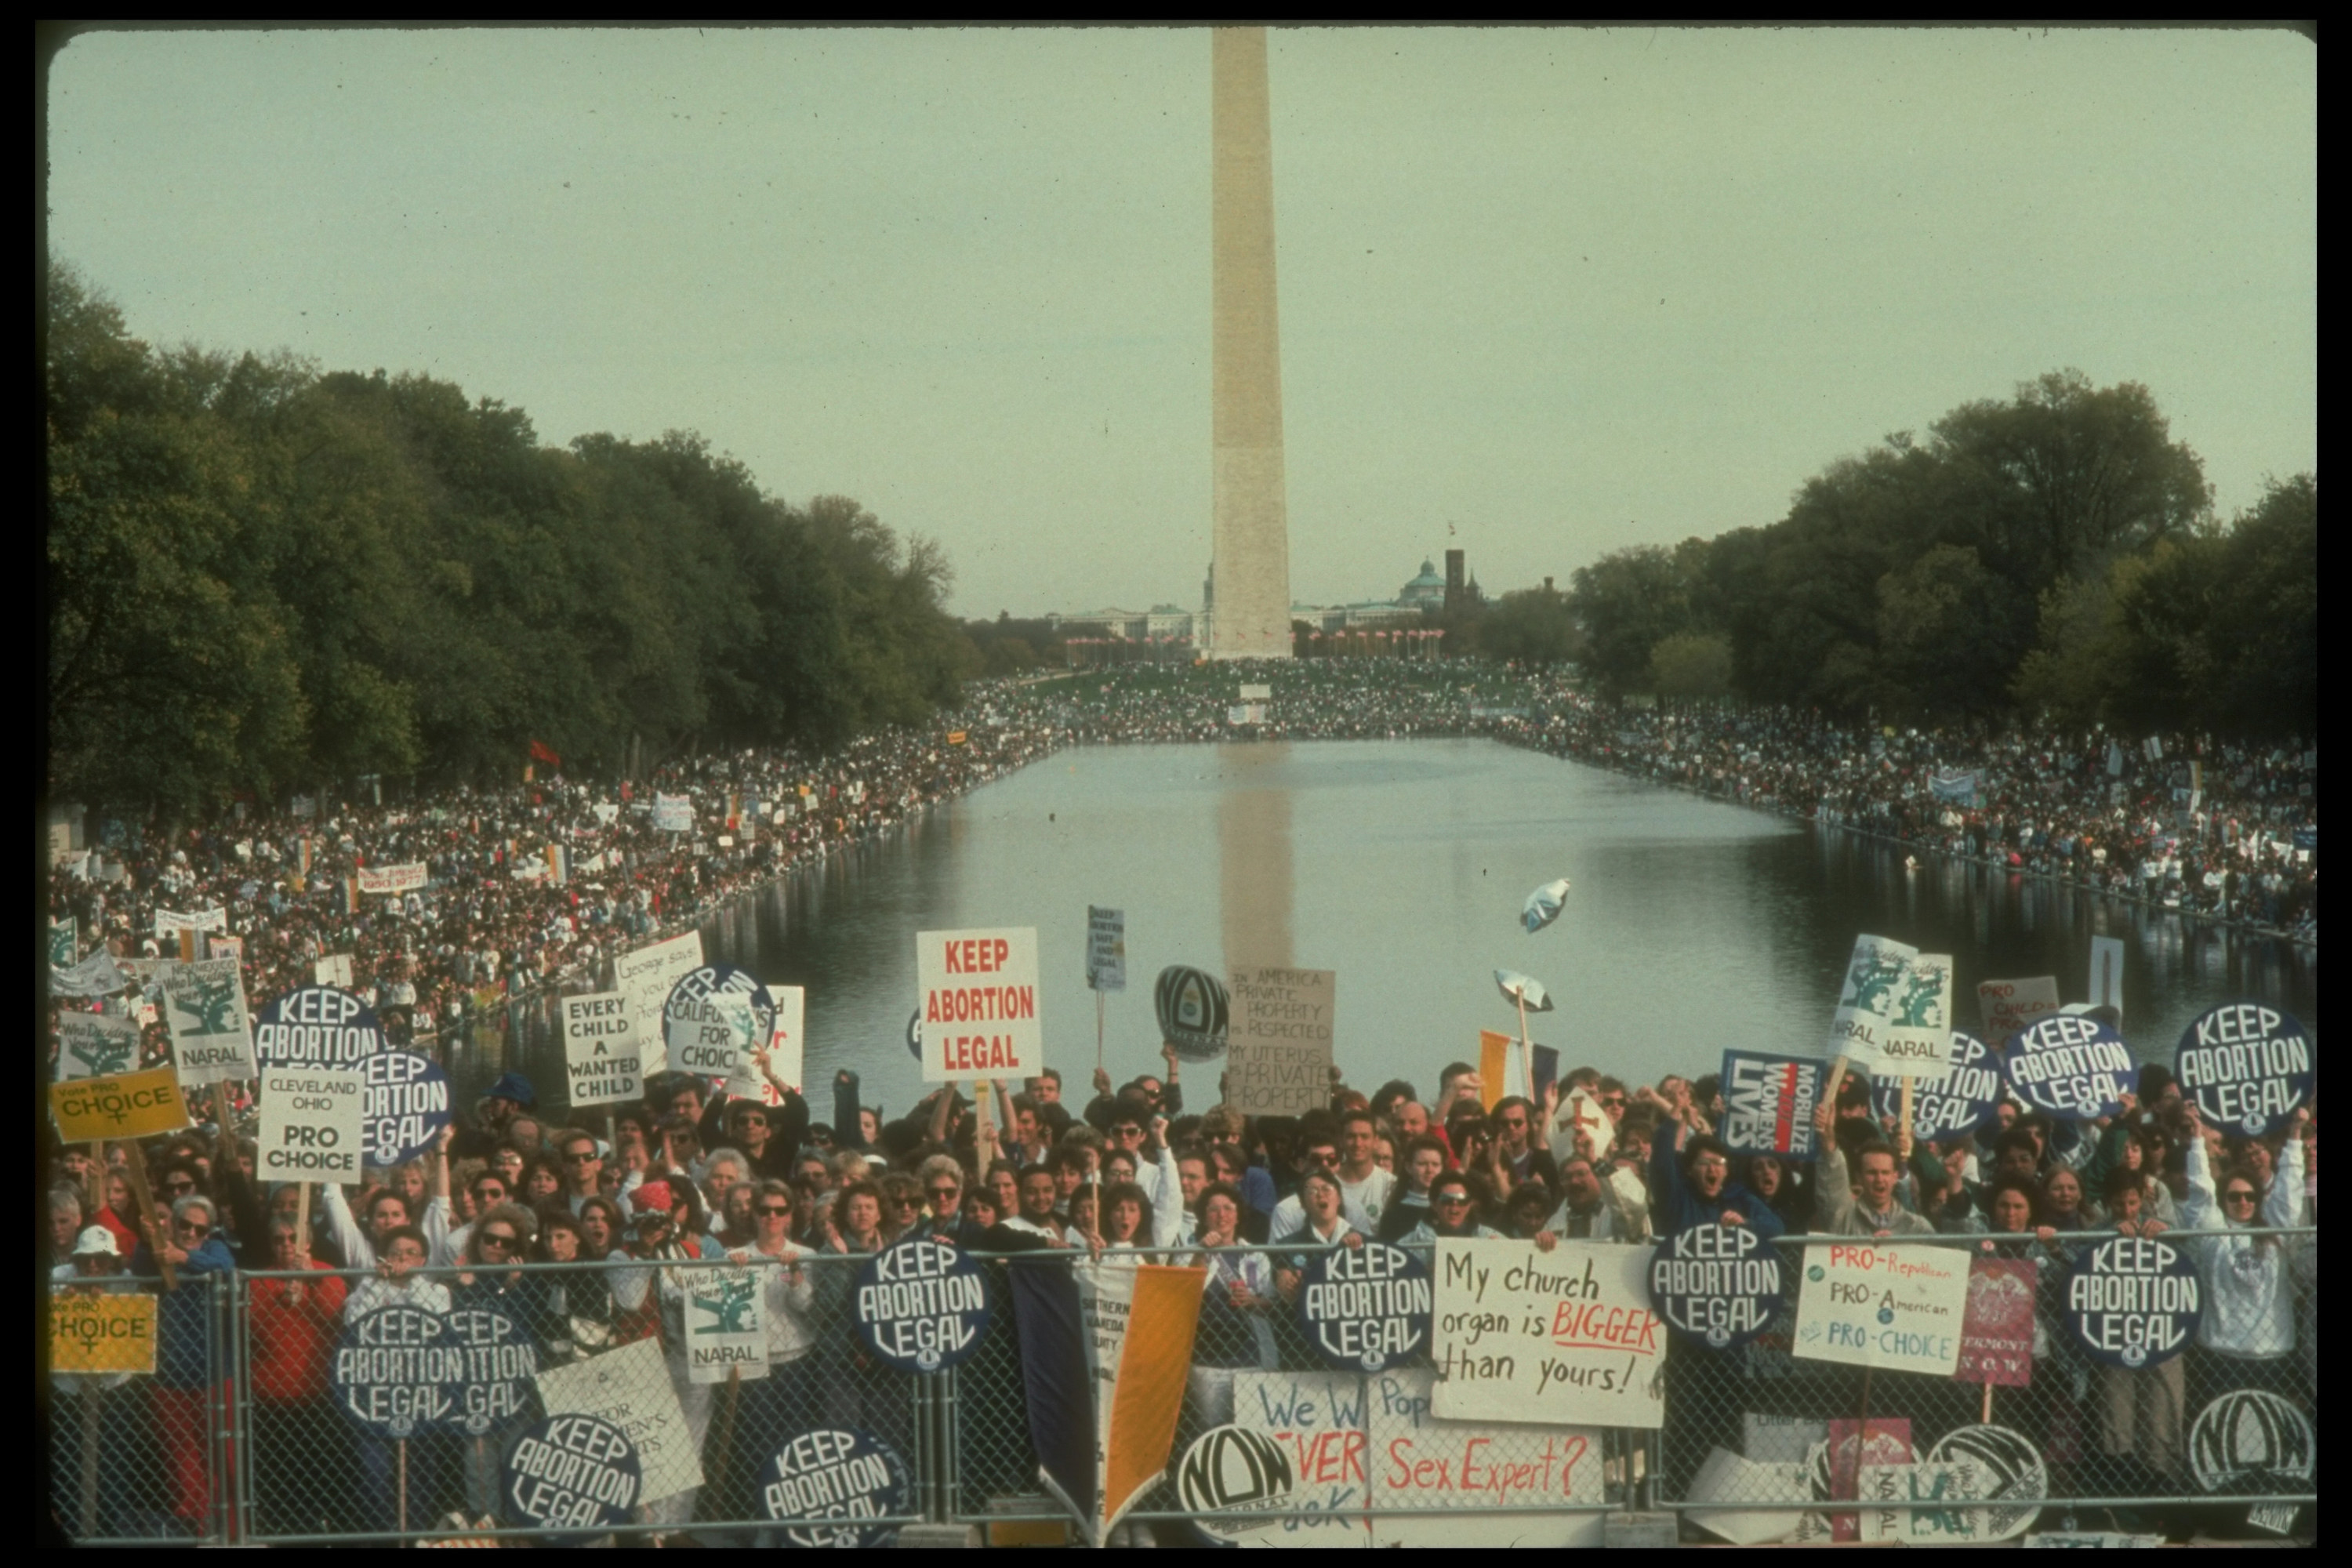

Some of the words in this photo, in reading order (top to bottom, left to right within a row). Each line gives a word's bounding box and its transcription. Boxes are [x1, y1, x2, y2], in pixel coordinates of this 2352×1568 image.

[619, 955, 664, 979] George
[945, 939, 1009, 974] KEEP
[1236, 983, 1299, 1002] PRIVATE
[1257, 970, 1323, 986] AMERICA
[1979, 984, 2014, 1000] PRO
[279, 989, 360, 1024] KEEP
[569, 998, 626, 1018] EVERY
[927, 985, 1033, 1022] ABORTION
[1247, 1003, 1323, 1021] PROPERTY
[257, 1024, 378, 1062] ABORTION
[570, 1019, 628, 1037] CHILD
[699, 1026, 731, 1046] FOR
[1248, 1019, 1330, 1040] RESPECTED
[2021, 1016, 2100, 1052] KEEP
[2197, 1004, 2281, 1046] KEEP
[182, 1047, 244, 1065] NARAL
[593, 1040, 608, 1055] A
[682, 1046, 738, 1069] CHOIC
[943, 1035, 1019, 1070] LEGAL
[1229, 1046, 1247, 1059] MY
[1254, 1046, 1323, 1064] UTERUS
[2010, 1041, 2132, 1085] ABORTION
[2180, 1036, 2310, 1088] ABORTION
[270, 1078, 357, 1094] CLEVELAND
[568, 1058, 640, 1078] WANTED
[1246, 1064, 1330, 1087] PRIVATE
[58, 1087, 87, 1098] Vote
[90, 1082, 120, 1094] PRO
[62, 1086, 173, 1117] CHOICE
[292, 1097, 332, 1111] OHIO
[363, 1080, 448, 1119] ORTION
[575, 1078, 634, 1098] CHILD
[1228, 1084, 1330, 1110] PROPERTY
[1726, 1058, 1765, 1149] LIVES
[2029, 1073, 2129, 1110] LEGAL
[2197, 1079, 2302, 1123] LEGAL
[1791, 1065, 1817, 1154] MOBILIZE
[284, 1125, 339, 1148] PRO
[361, 1116, 436, 1152] EGAL
[267, 1149, 354, 1171] CHOICE
[1675, 1223, 1758, 1258] KEEP
[2092, 1238, 2177, 1273] KEEP
[877, 1241, 957, 1282] KEEP
[1325, 1243, 1407, 1281] KEEP
[1446, 1251, 1489, 1303] My
[1504, 1254, 1599, 1300] church
[1653, 1258, 1780, 1295] ABORTION
[1830, 1245, 1951, 1279] PRO-Republican
[684, 1272, 709, 1288] Who
[858, 1273, 985, 1323] ABORTION
[2071, 1275, 2198, 1312] ABORTION
[73, 1301, 101, 1312] PRO
[1306, 1278, 1431, 1320] ABORTION
[1665, 1297, 1769, 1332] LEGAL
[1830, 1282, 1949, 1316] PRO-American
[359, 1310, 441, 1345] KEEP
[873, 1315, 975, 1358] LEGAL
[1319, 1318, 1421, 1357] LEGAL
[1442, 1310, 1509, 1345] organ
[1523, 1305, 1545, 1337] is
[1552, 1301, 1661, 1349] BIGGER
[1828, 1321, 1953, 1360] PRO-CHOICE
[2082, 1314, 2186, 1351] LEGAL
[694, 1345, 760, 1364] NARAL
[1962, 1336, 2028, 1352] ERMONT
[337, 1348, 463, 1384] ABORTION
[1437, 1342, 1515, 1381] than
[1537, 1355, 1635, 1396] yours!
[349, 1385, 452, 1422] LEGAL
[1259, 1382, 1316, 1428] We
[546, 1418, 628, 1462] KEEP
[2194, 1395, 2309, 1475] NOW
[775, 1430, 855, 1478] KEEP
[1183, 1427, 1293, 1512] NOW
[1275, 1429, 1367, 1483] VER
[1388, 1438, 1454, 1491] Sex
[1461, 1435, 1589, 1506] Expert?
[510, 1437, 636, 1510] ABORTION
[764, 1453, 891, 1519] ABORTION
[512, 1474, 609, 1529] LEGAL
